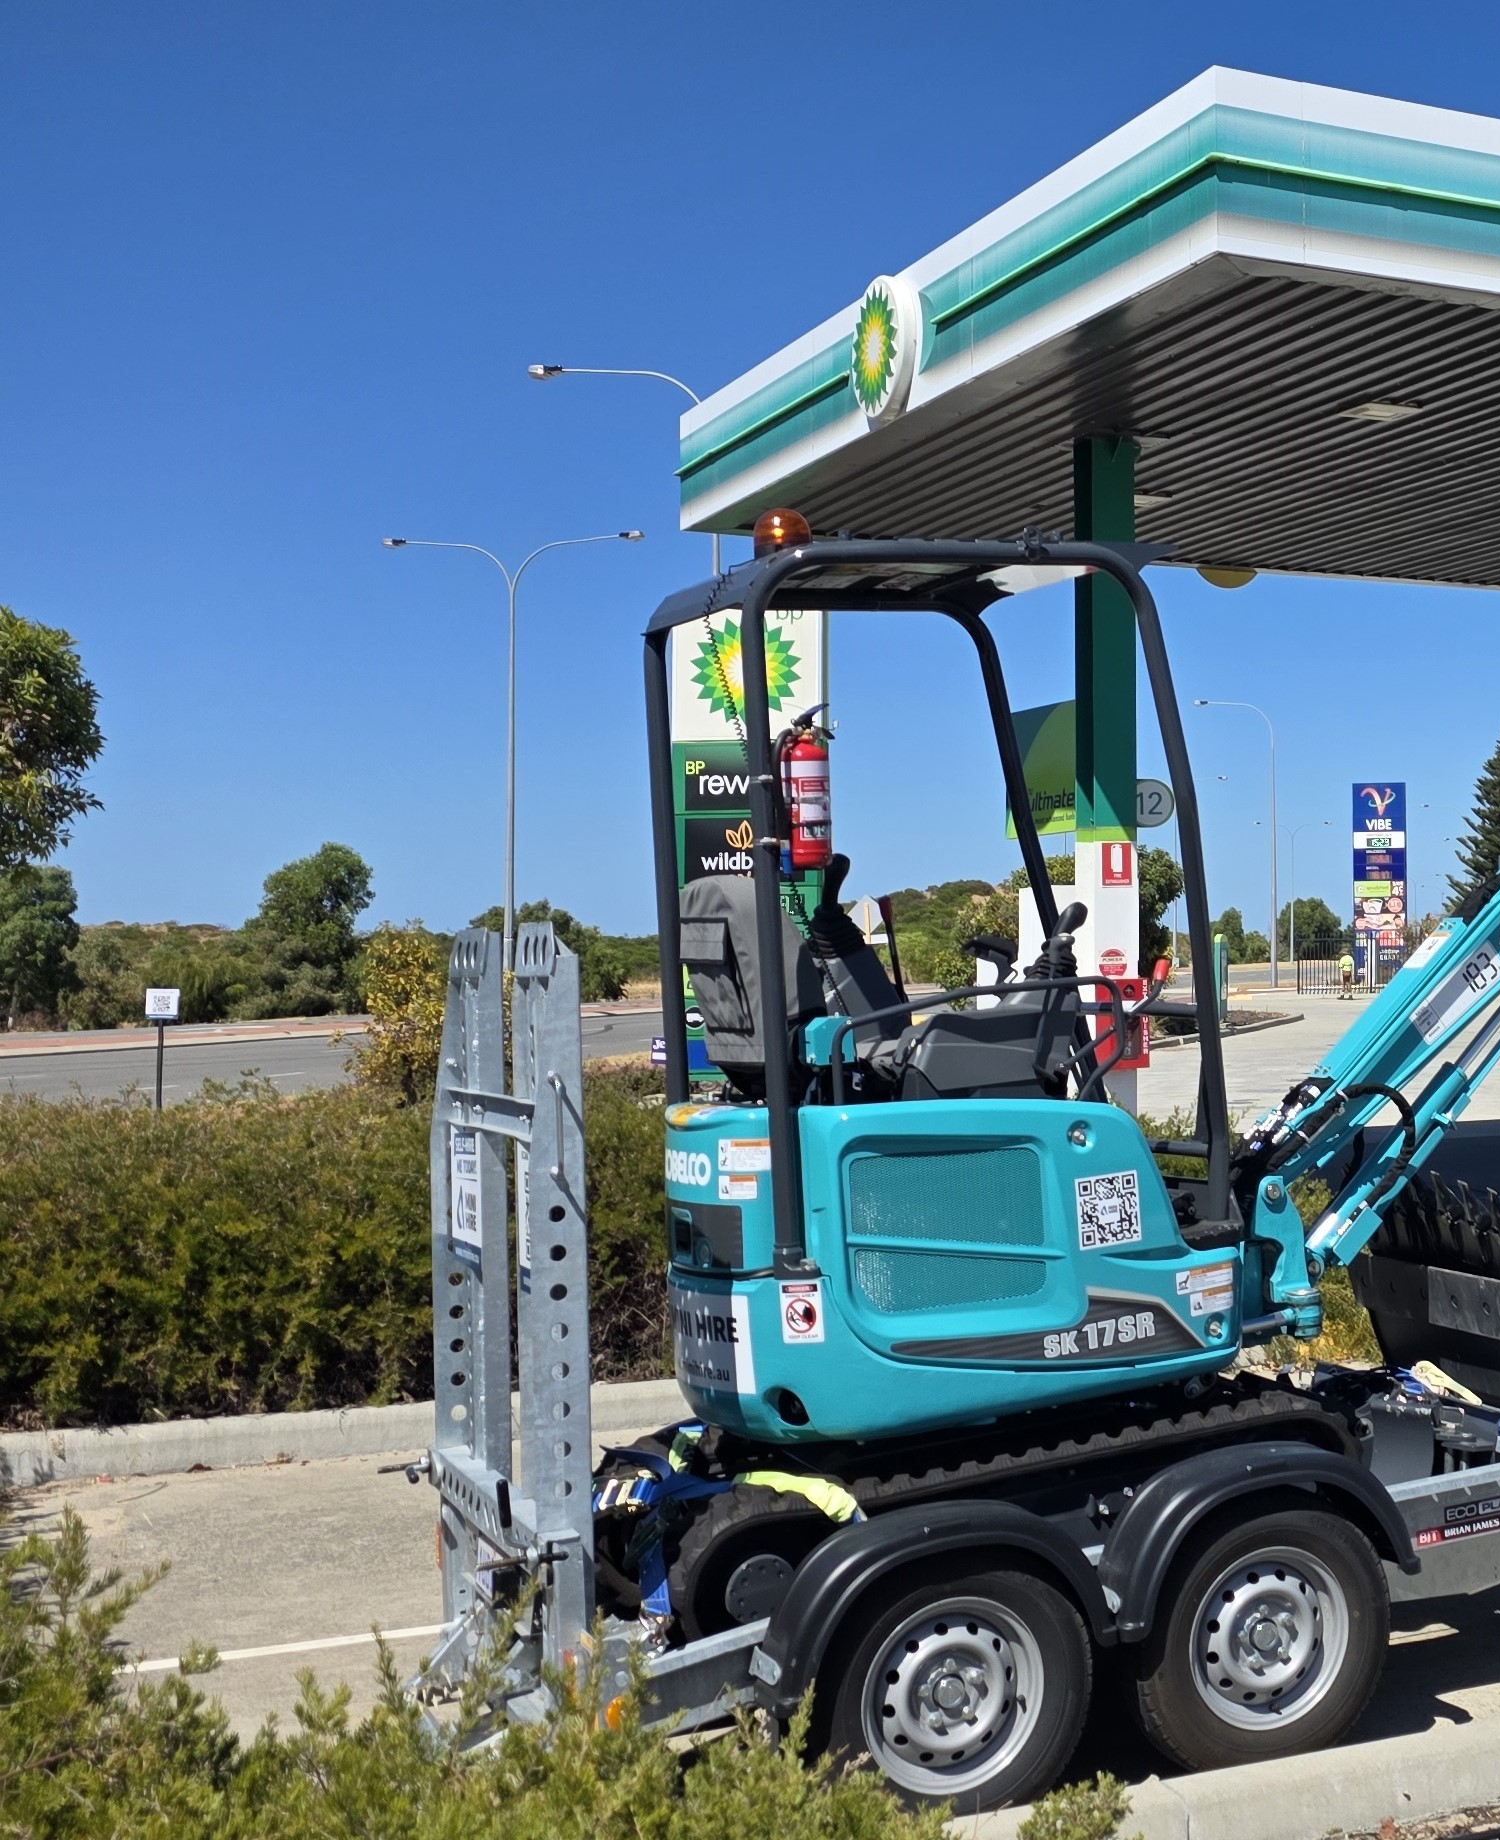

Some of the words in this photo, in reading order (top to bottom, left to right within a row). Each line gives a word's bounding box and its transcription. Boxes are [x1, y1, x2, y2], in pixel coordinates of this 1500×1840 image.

[685, 761, 706, 775] BP
[1136, 791, 1163, 815] 12
[1365, 818, 1393, 831] VIBE
[1141, 978, 1150, 1055] EXTUISHER
[694, 1311, 739, 1343] HIRE
[1043, 1330, 1080, 1359] SK
[1081, 1311, 1156, 1350] 17SR
[1446, 1506, 1478, 1521] ECO
[1443, 1523, 1472, 1538] BRIAN
[1472, 1516, 1500, 1533] JAMES
